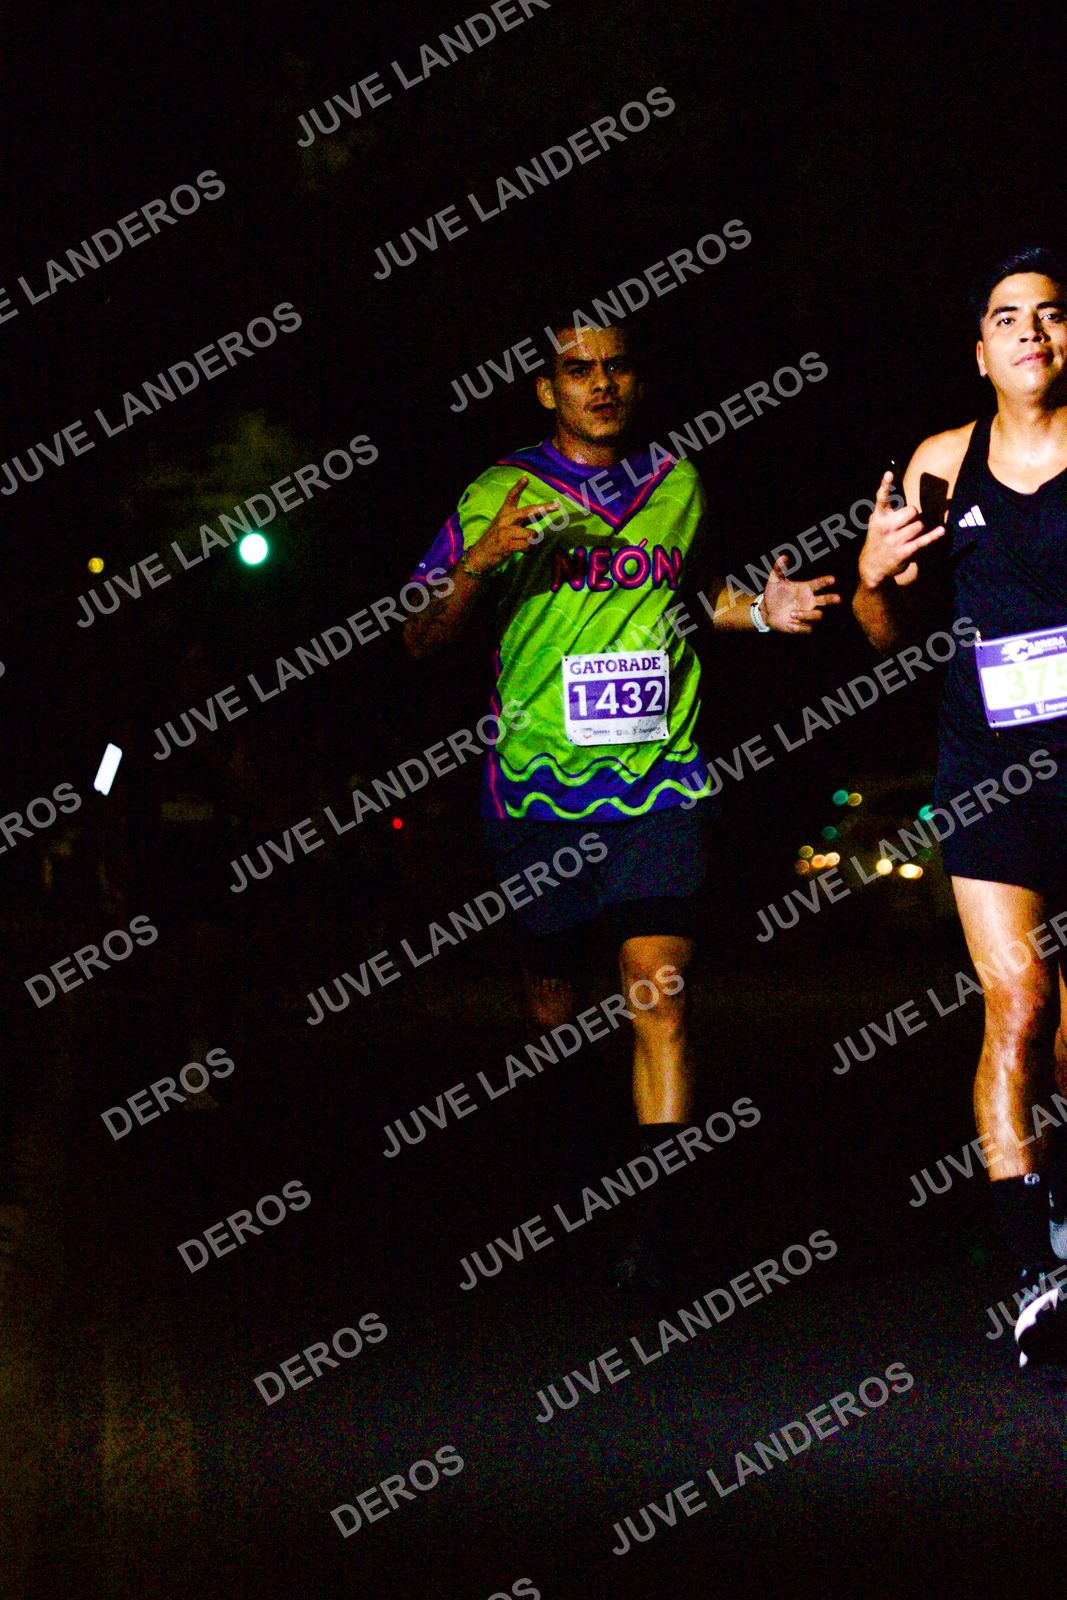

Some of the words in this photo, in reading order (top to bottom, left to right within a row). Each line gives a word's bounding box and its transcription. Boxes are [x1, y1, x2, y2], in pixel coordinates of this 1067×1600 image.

[551, 538, 683, 592] NEÓN
[570, 656, 661, 676] GATORADE
[573, 679, 663, 717] 1432
